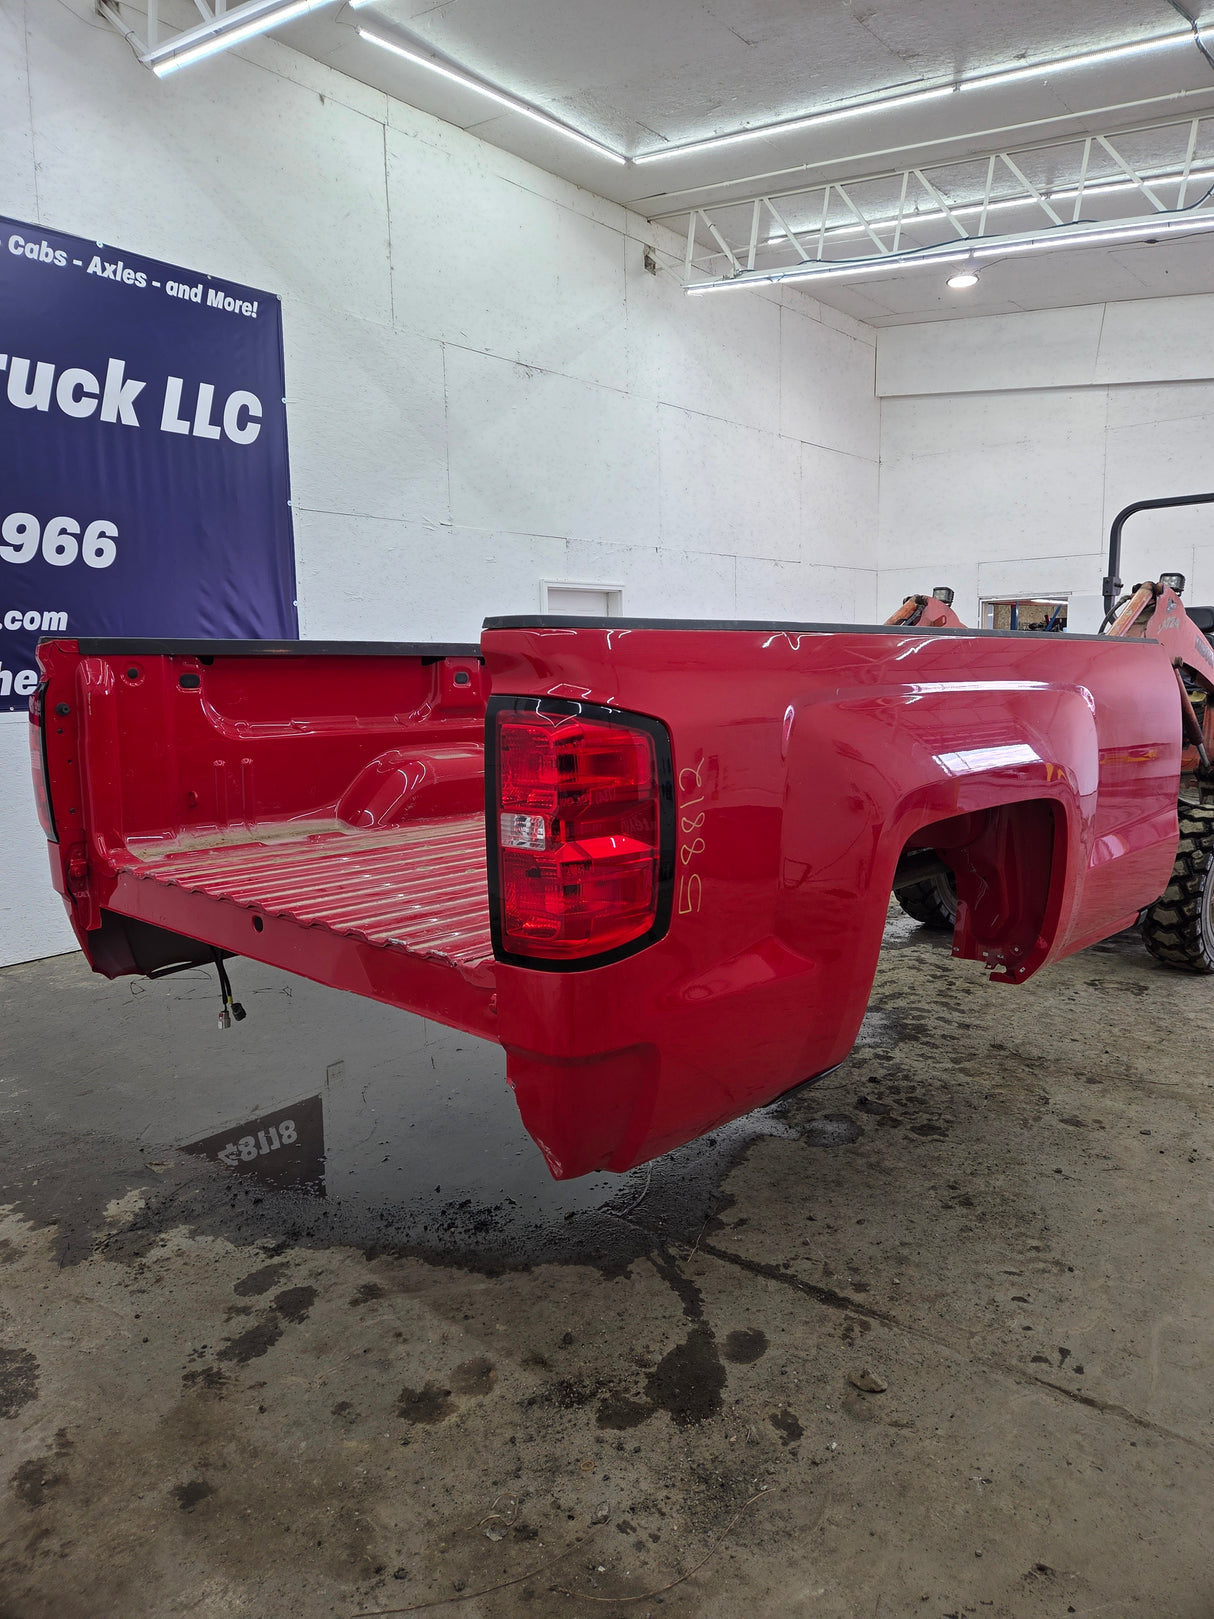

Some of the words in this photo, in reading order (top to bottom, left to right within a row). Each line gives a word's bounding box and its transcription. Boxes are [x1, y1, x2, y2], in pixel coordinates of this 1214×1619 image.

[8, 234, 68, 267] Cabs
[73, 258, 83, 267] -
[87, 255, 147, 288] Axles
[152, 280, 161, 288] -
[165, 279, 202, 304] and
[206, 288, 258, 318] More!
[160, 375, 263, 445] LLC
[0, 512, 119, 569] 966
[678, 757, 706, 915] 58812
